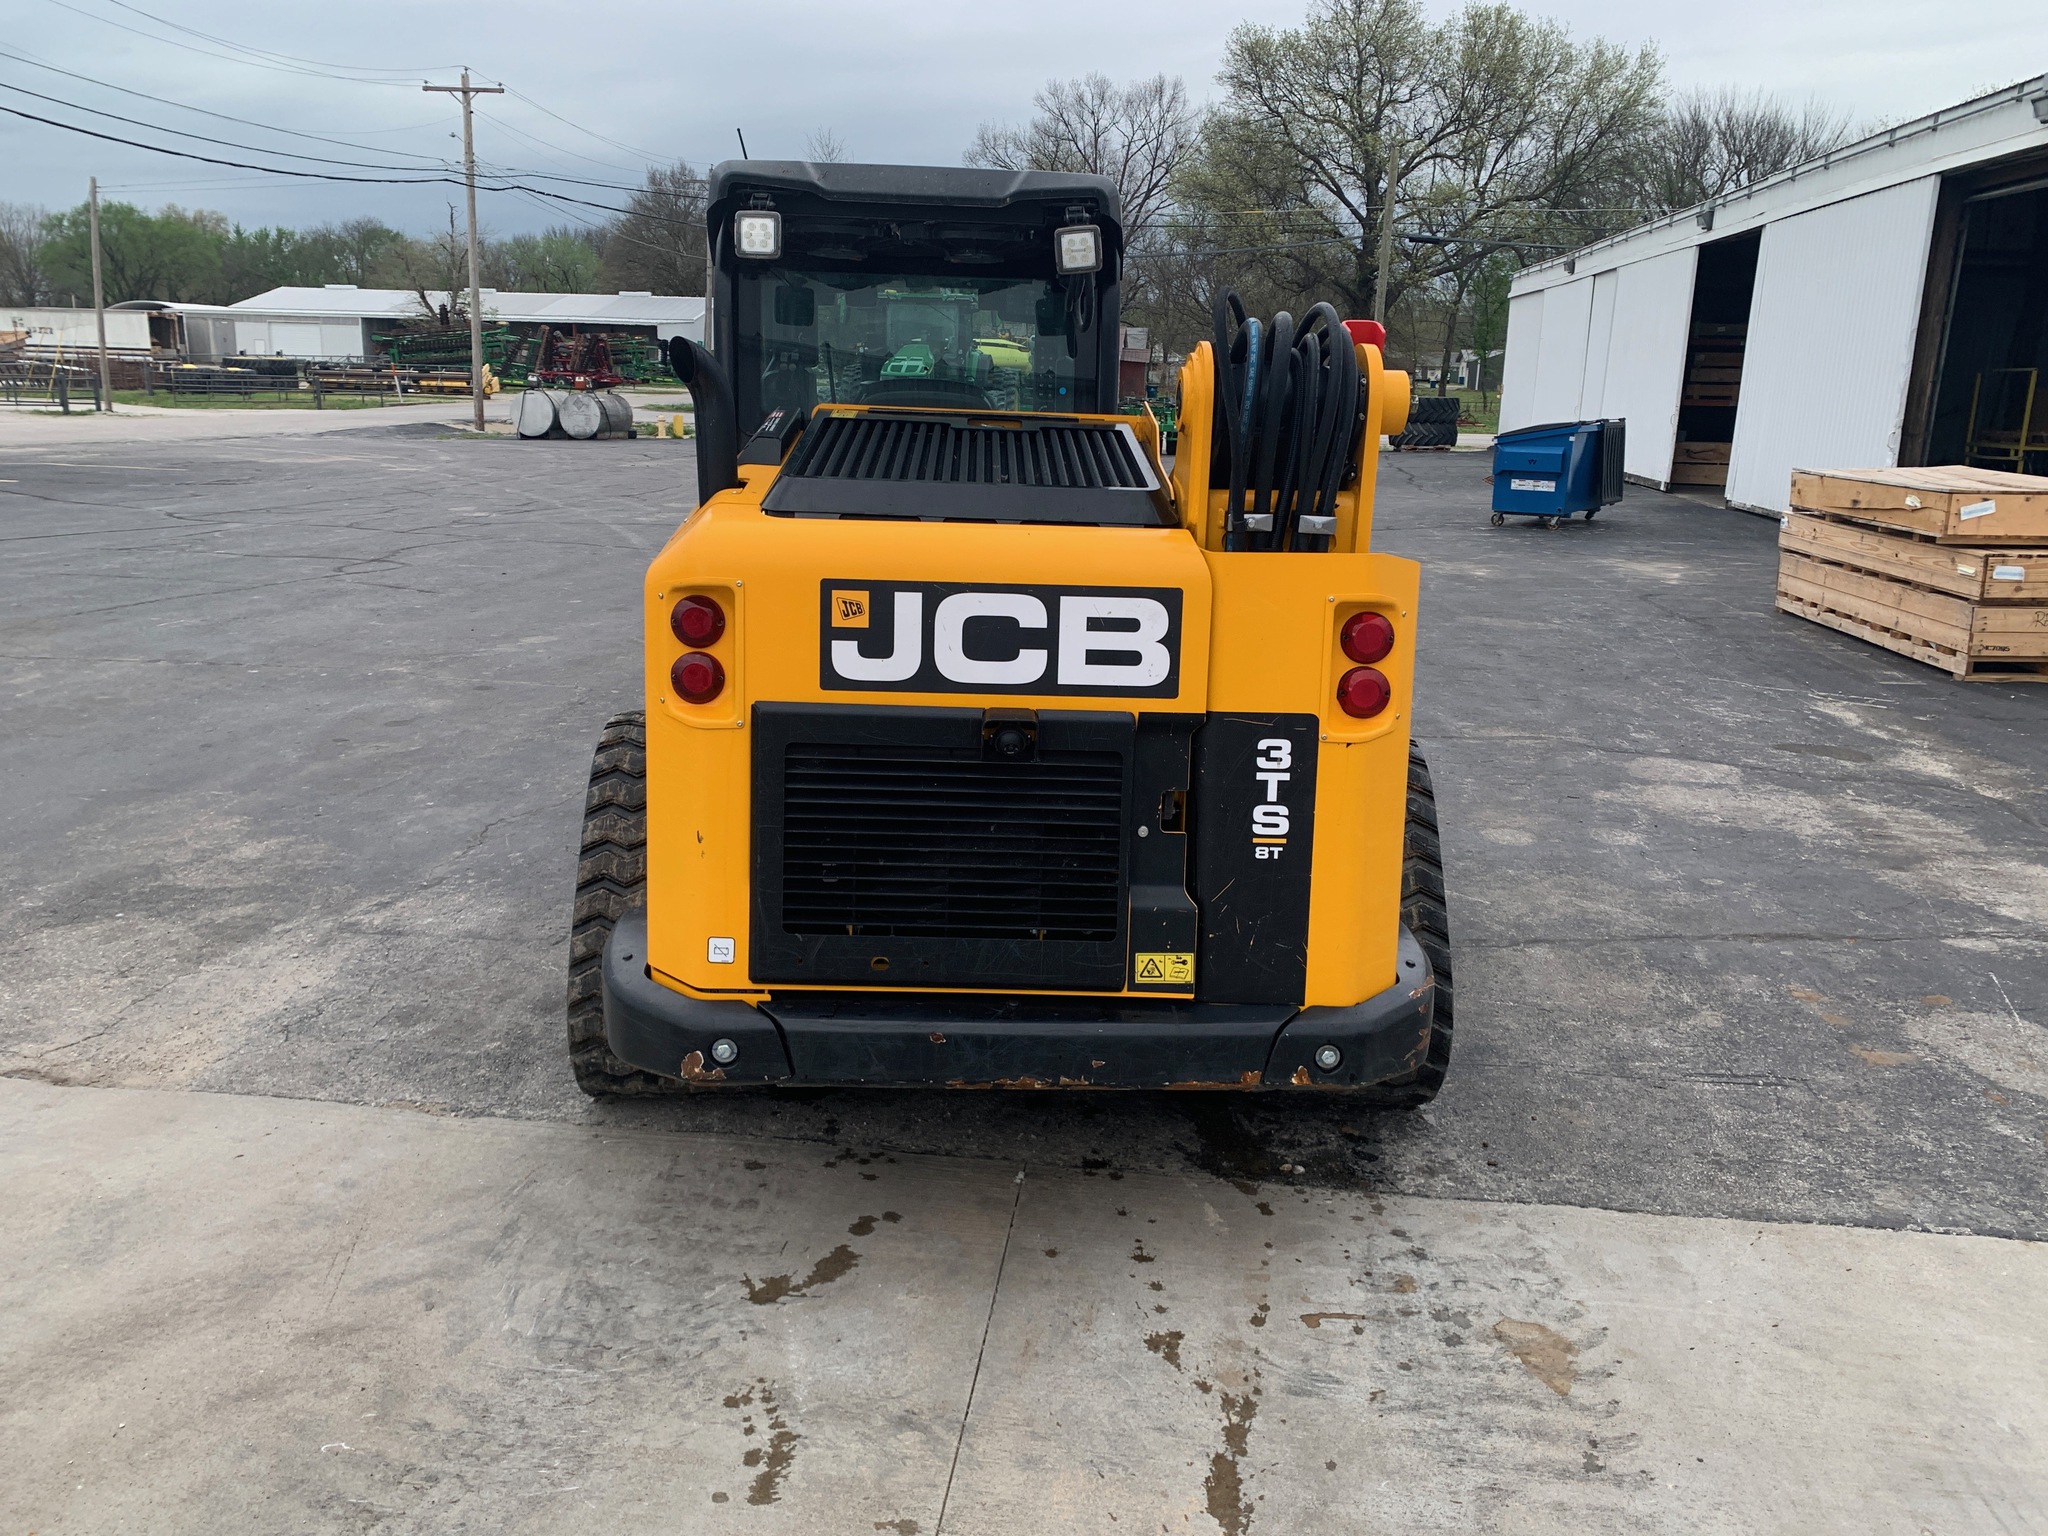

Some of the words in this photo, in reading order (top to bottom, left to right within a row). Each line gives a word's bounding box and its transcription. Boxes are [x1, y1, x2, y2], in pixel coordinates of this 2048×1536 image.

[842, 600, 863, 618] JCB
[831, 591, 1171, 687] JCB
[1252, 739, 1292, 835] 3TS
[1255, 846, 1283, 860] 8T
